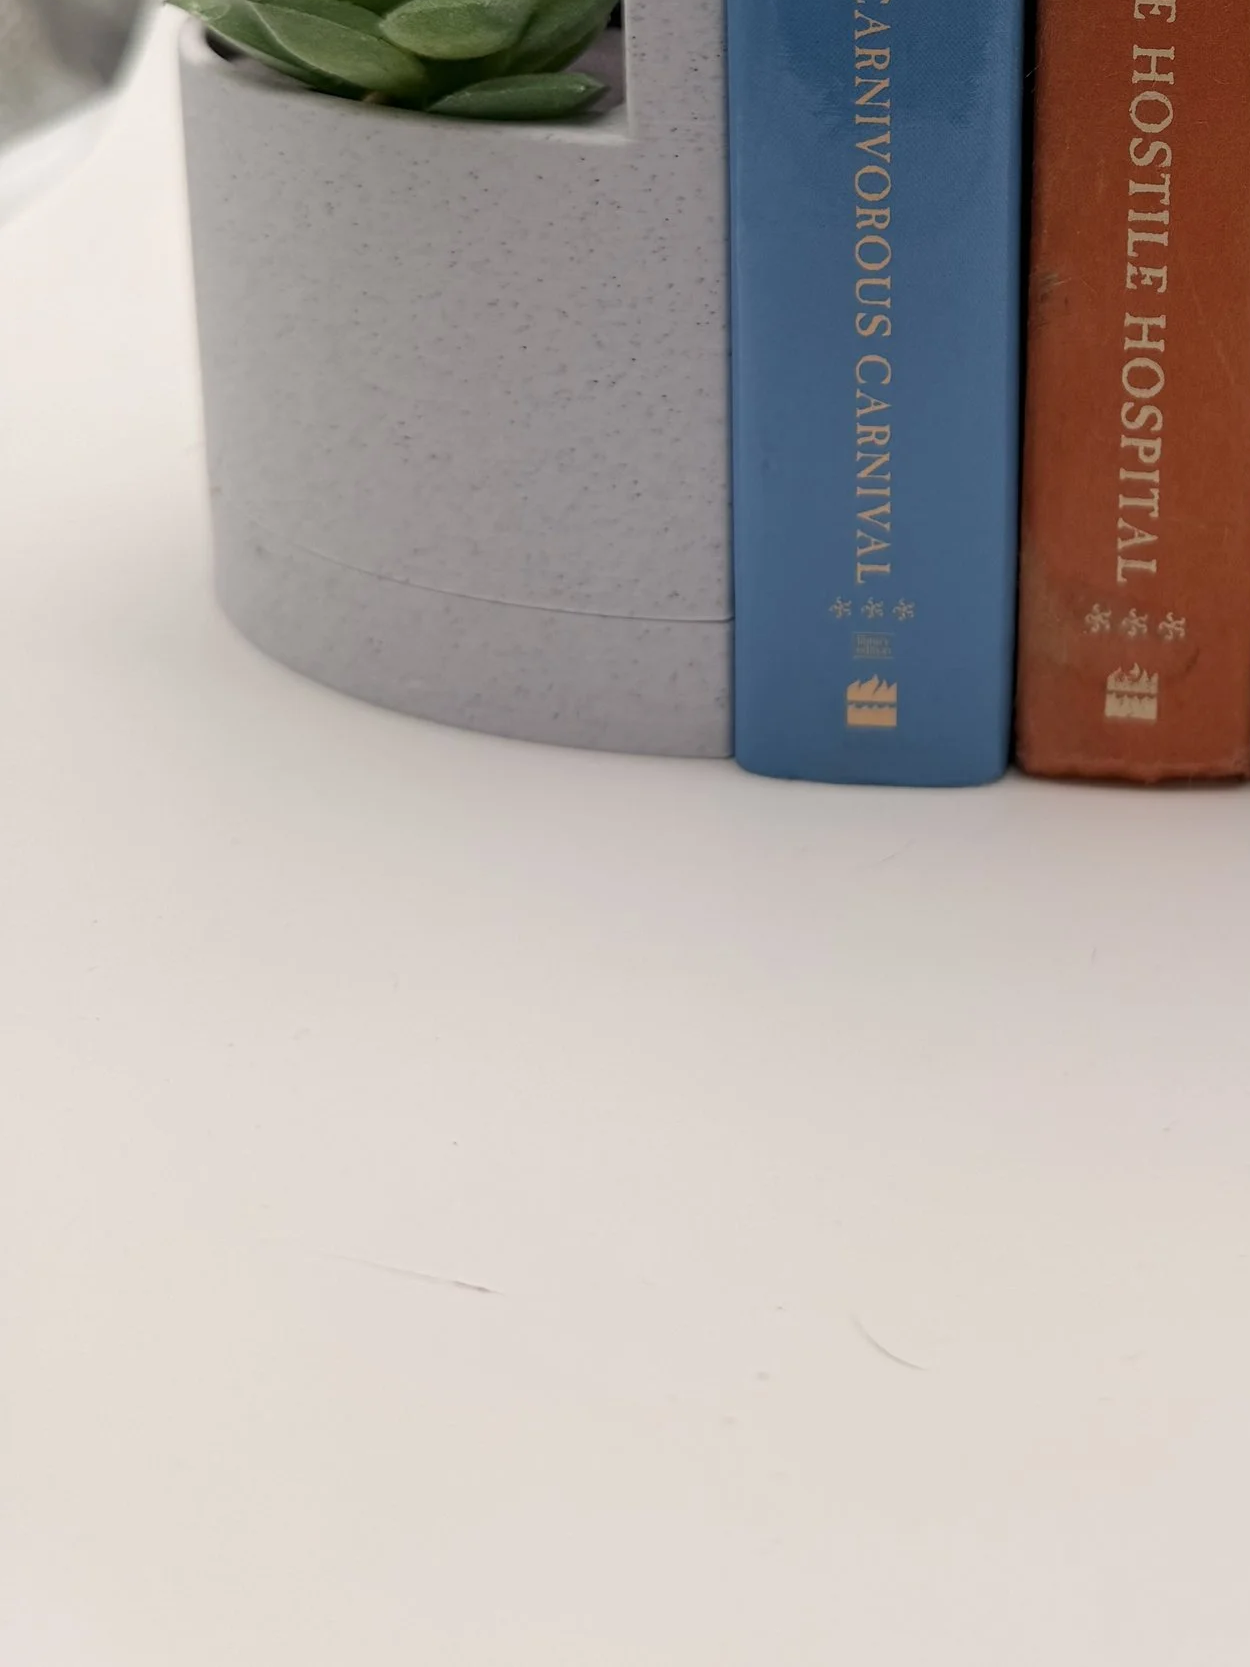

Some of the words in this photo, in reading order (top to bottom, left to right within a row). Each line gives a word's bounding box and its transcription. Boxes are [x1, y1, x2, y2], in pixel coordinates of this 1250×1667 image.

[1125, 43, 1176, 294] HOSTILE
[854, 354, 892, 585] CARNIVAL
[1116, 311, 1167, 584] HOSPITAL
